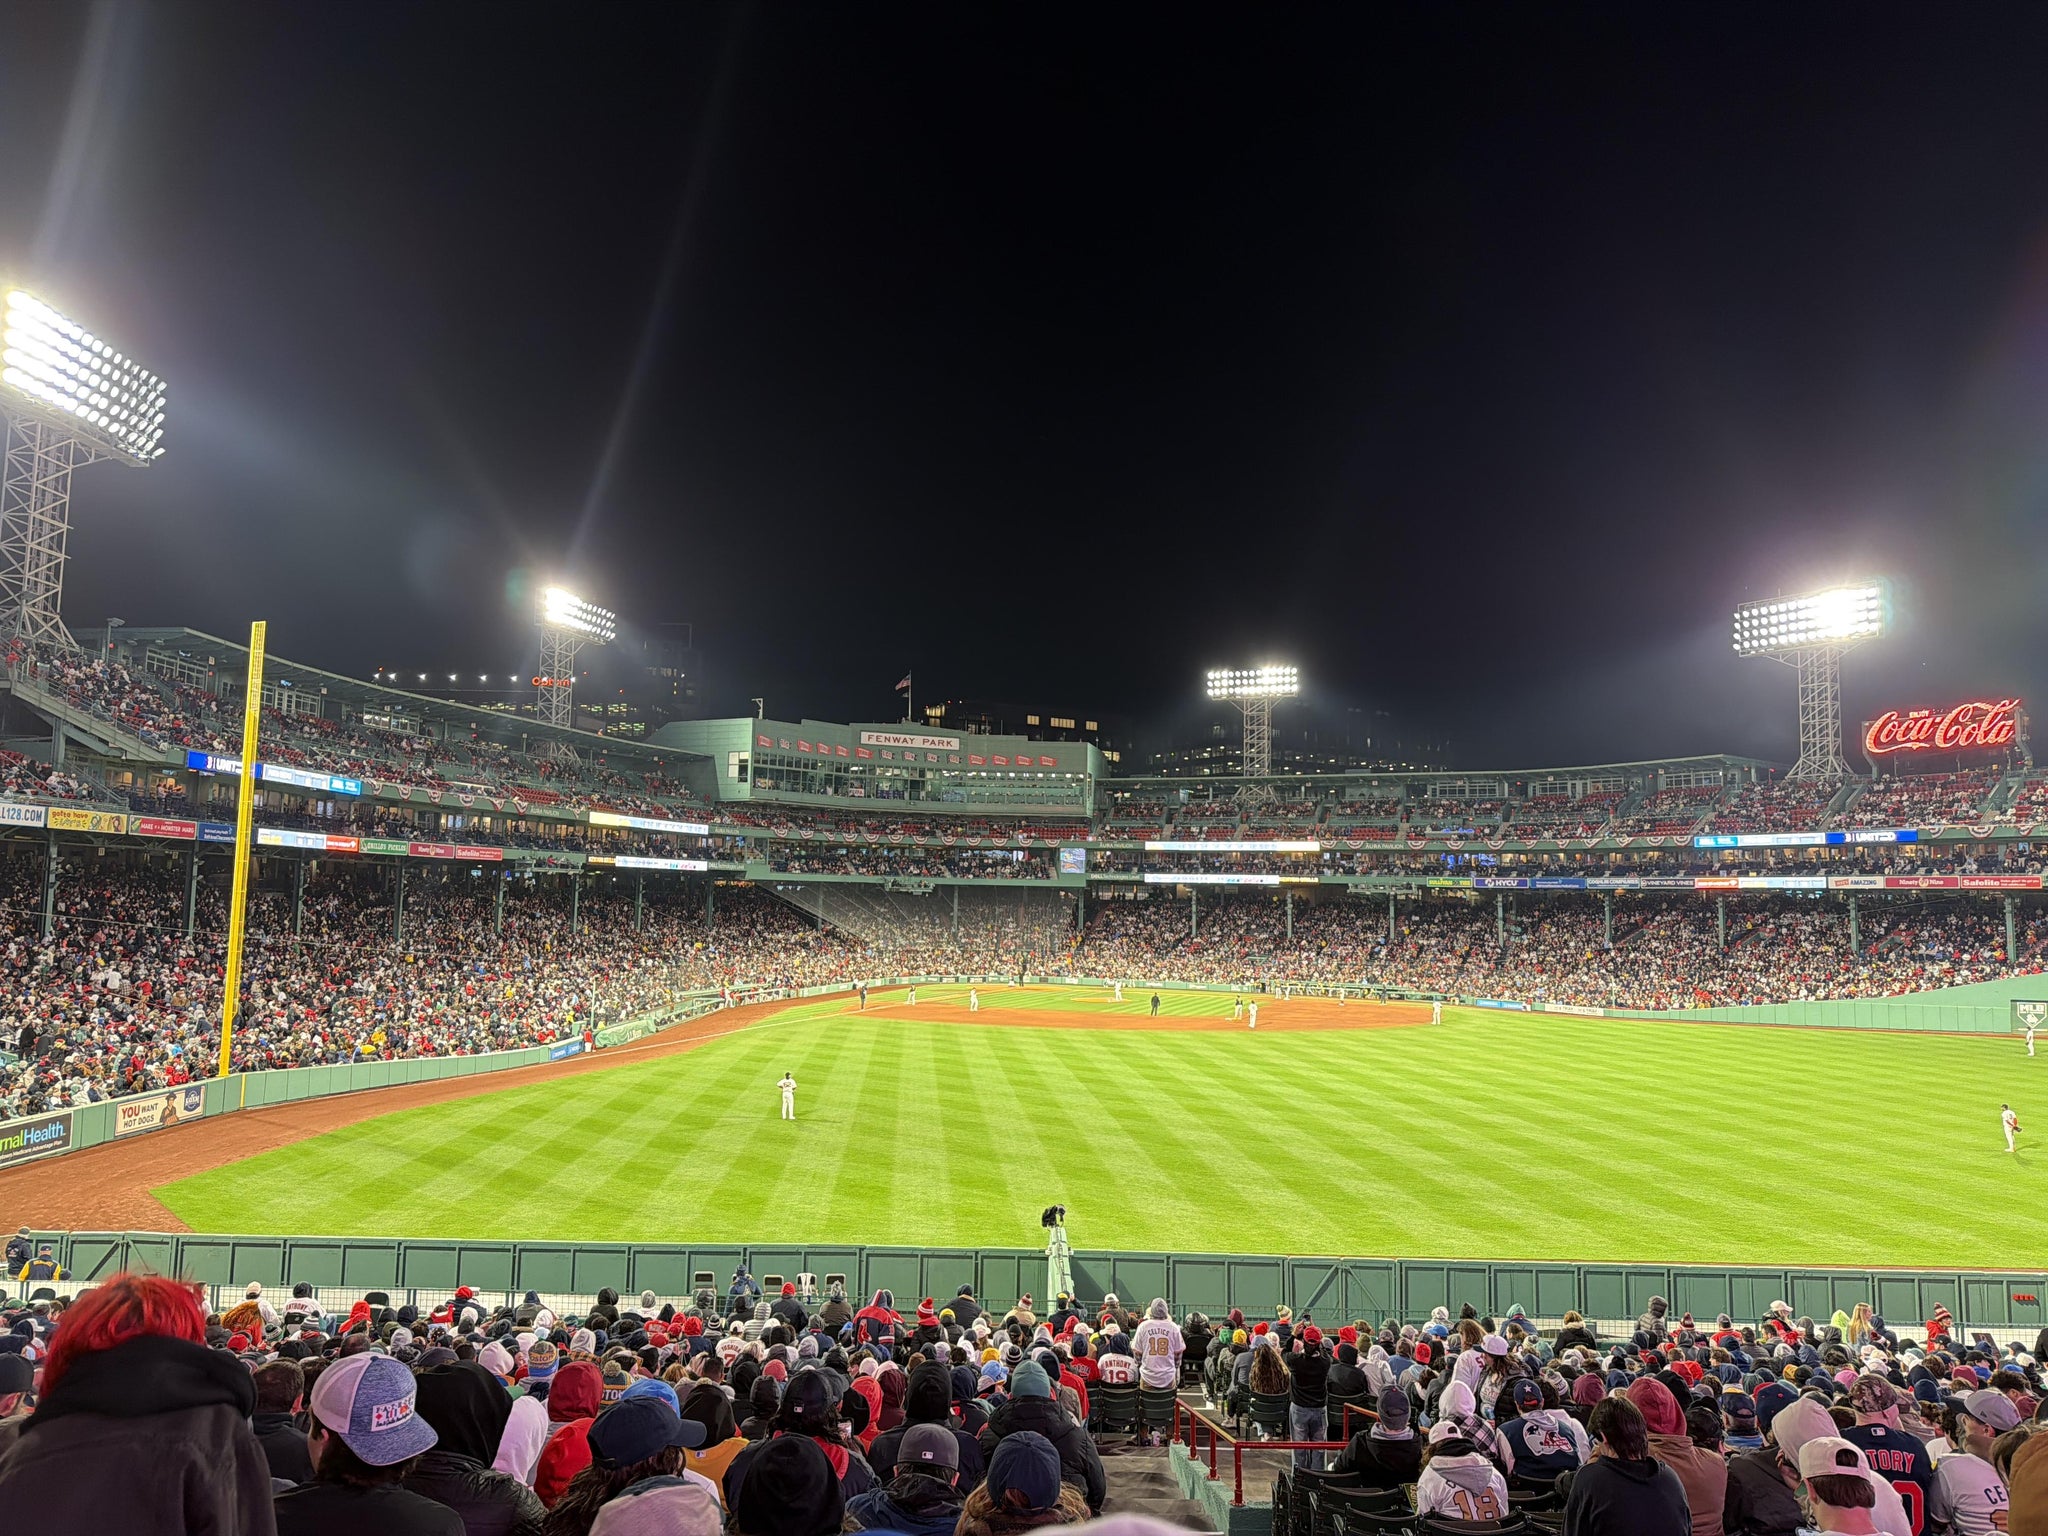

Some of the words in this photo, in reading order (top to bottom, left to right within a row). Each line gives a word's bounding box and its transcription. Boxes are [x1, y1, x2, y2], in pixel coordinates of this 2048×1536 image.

[1909, 709, 1930, 719] ENJOY
[1866, 699, 2021, 753] Coca-Cola
[867, 734, 915, 745] FENWAY
[922, 738, 953, 748] PARK
[0, 806, 43, 822] L128.COM
[51, 810, 71, 819] gotta
[73, 811, 89, 820] have
[160, 825, 181, 833] MONSTER
[1855, 831, 1896, 842] UNITED
[121, 1104, 140, 1120] YOU
[141, 1103, 158, 1113] WANT
[123, 1118, 136, 1129] HOT
[138, 1114, 154, 1125] DOGS
[1147, 1327, 1170, 1337] CELTICS
[1148, 1336, 1169, 1356] 18
[724, 1353, 736, 1367] 7
[1104, 1359, 1131, 1369] ANTHONY
[1108, 1369, 1128, 1384] 19
[1865, 1449, 1915, 1474] TORY
[1984, 1485, 2007, 1505] CE
[1452, 1486, 1501, 1521] 18
